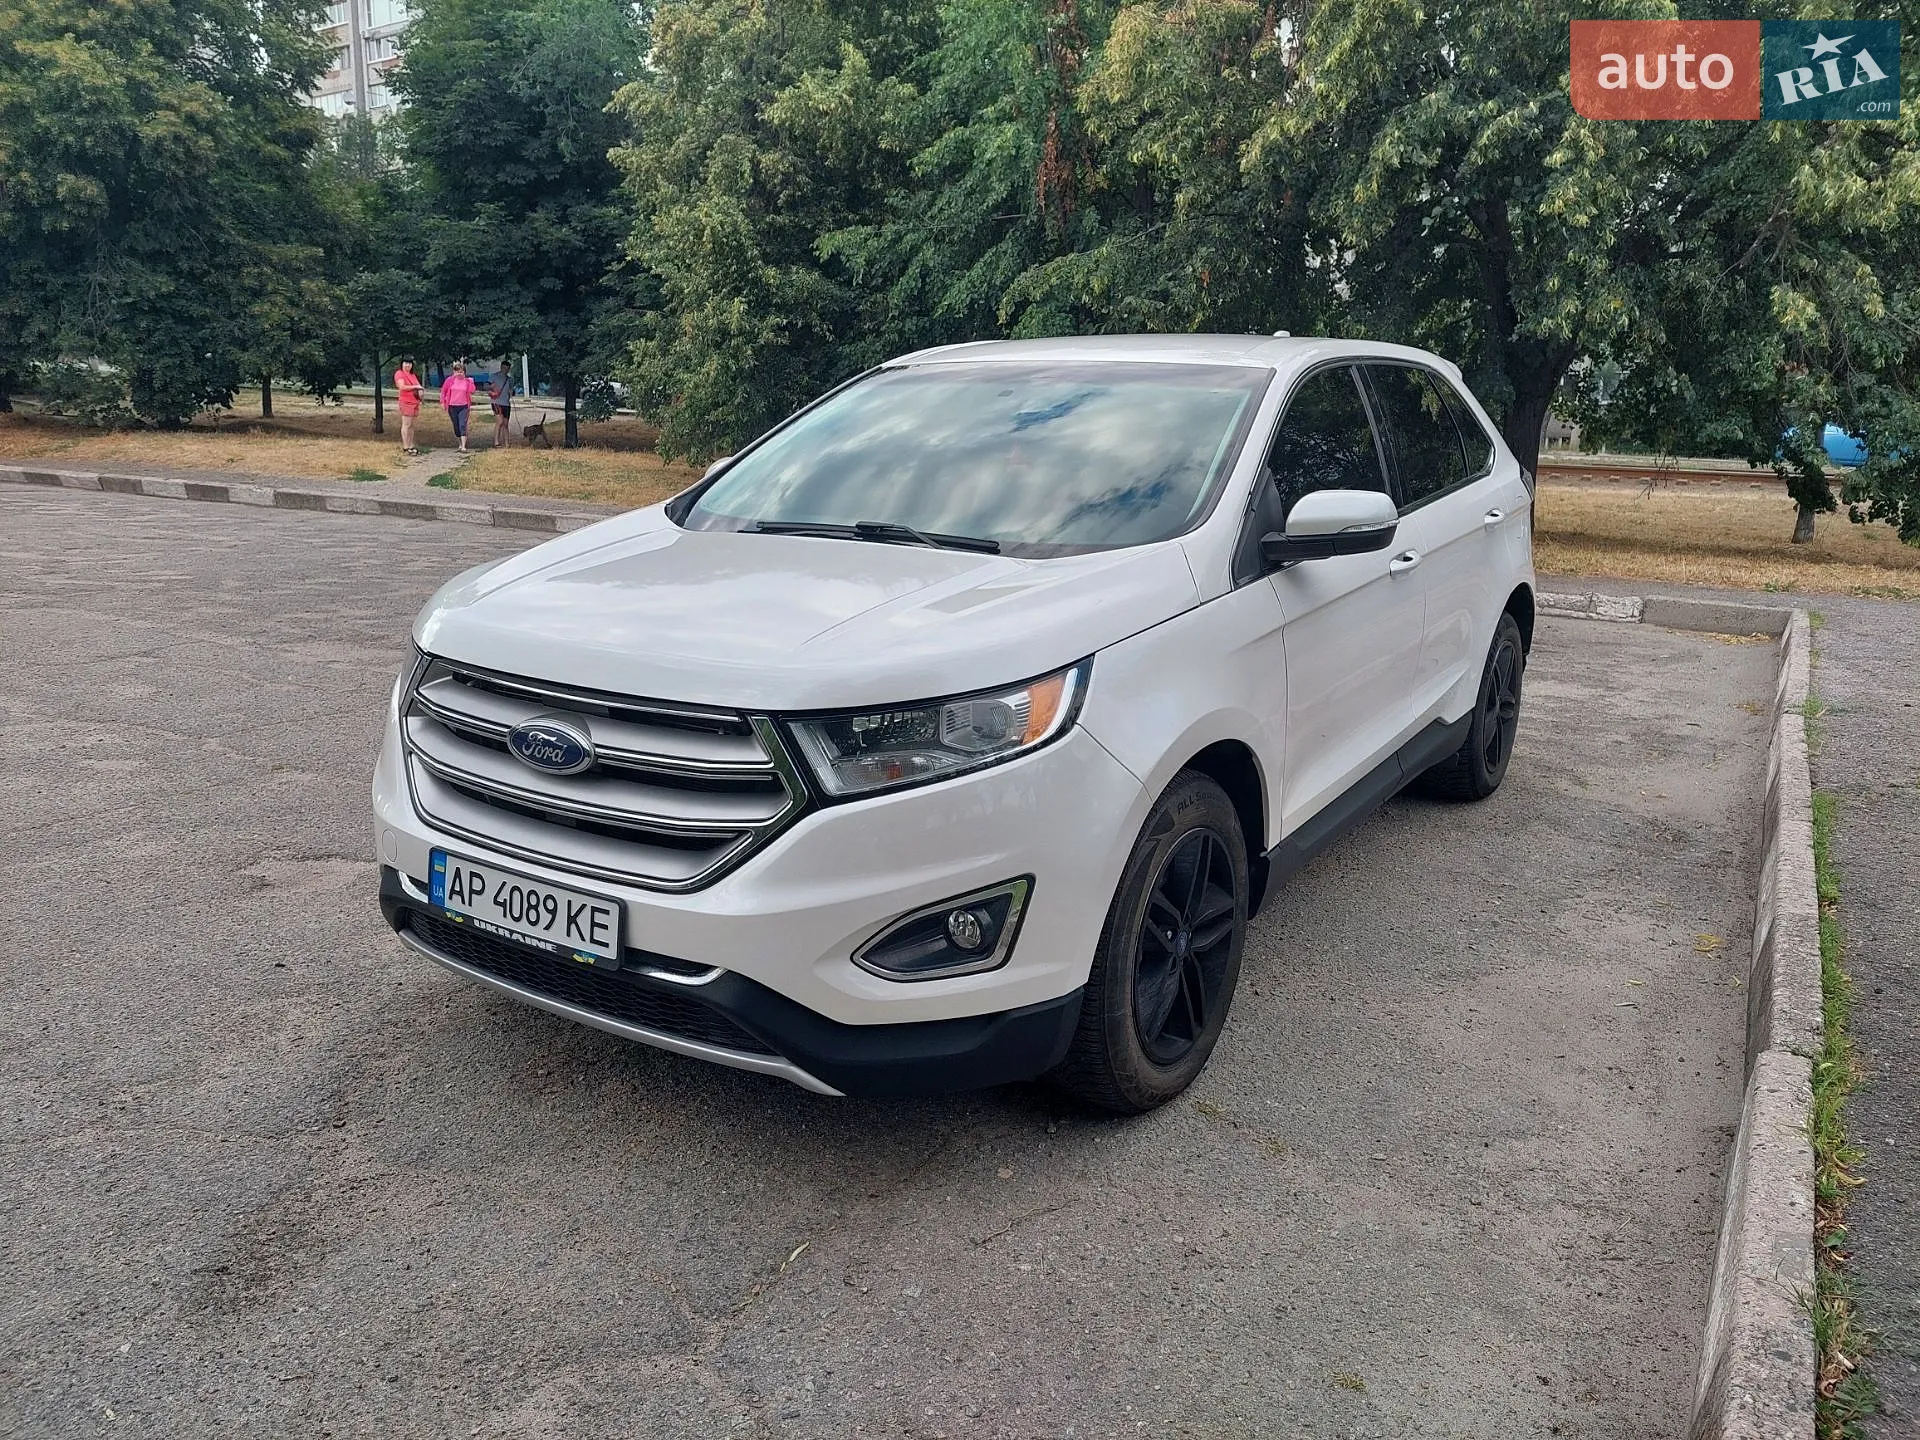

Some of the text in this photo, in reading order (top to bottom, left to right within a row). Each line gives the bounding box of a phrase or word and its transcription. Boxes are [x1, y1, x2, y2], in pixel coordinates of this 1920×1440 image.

[522, 731, 568, 763] Ford
[433, 885, 444, 898] UA
[448, 866, 610, 949] AP 4089 KE
[473, 918, 557, 953] UKRAINE
